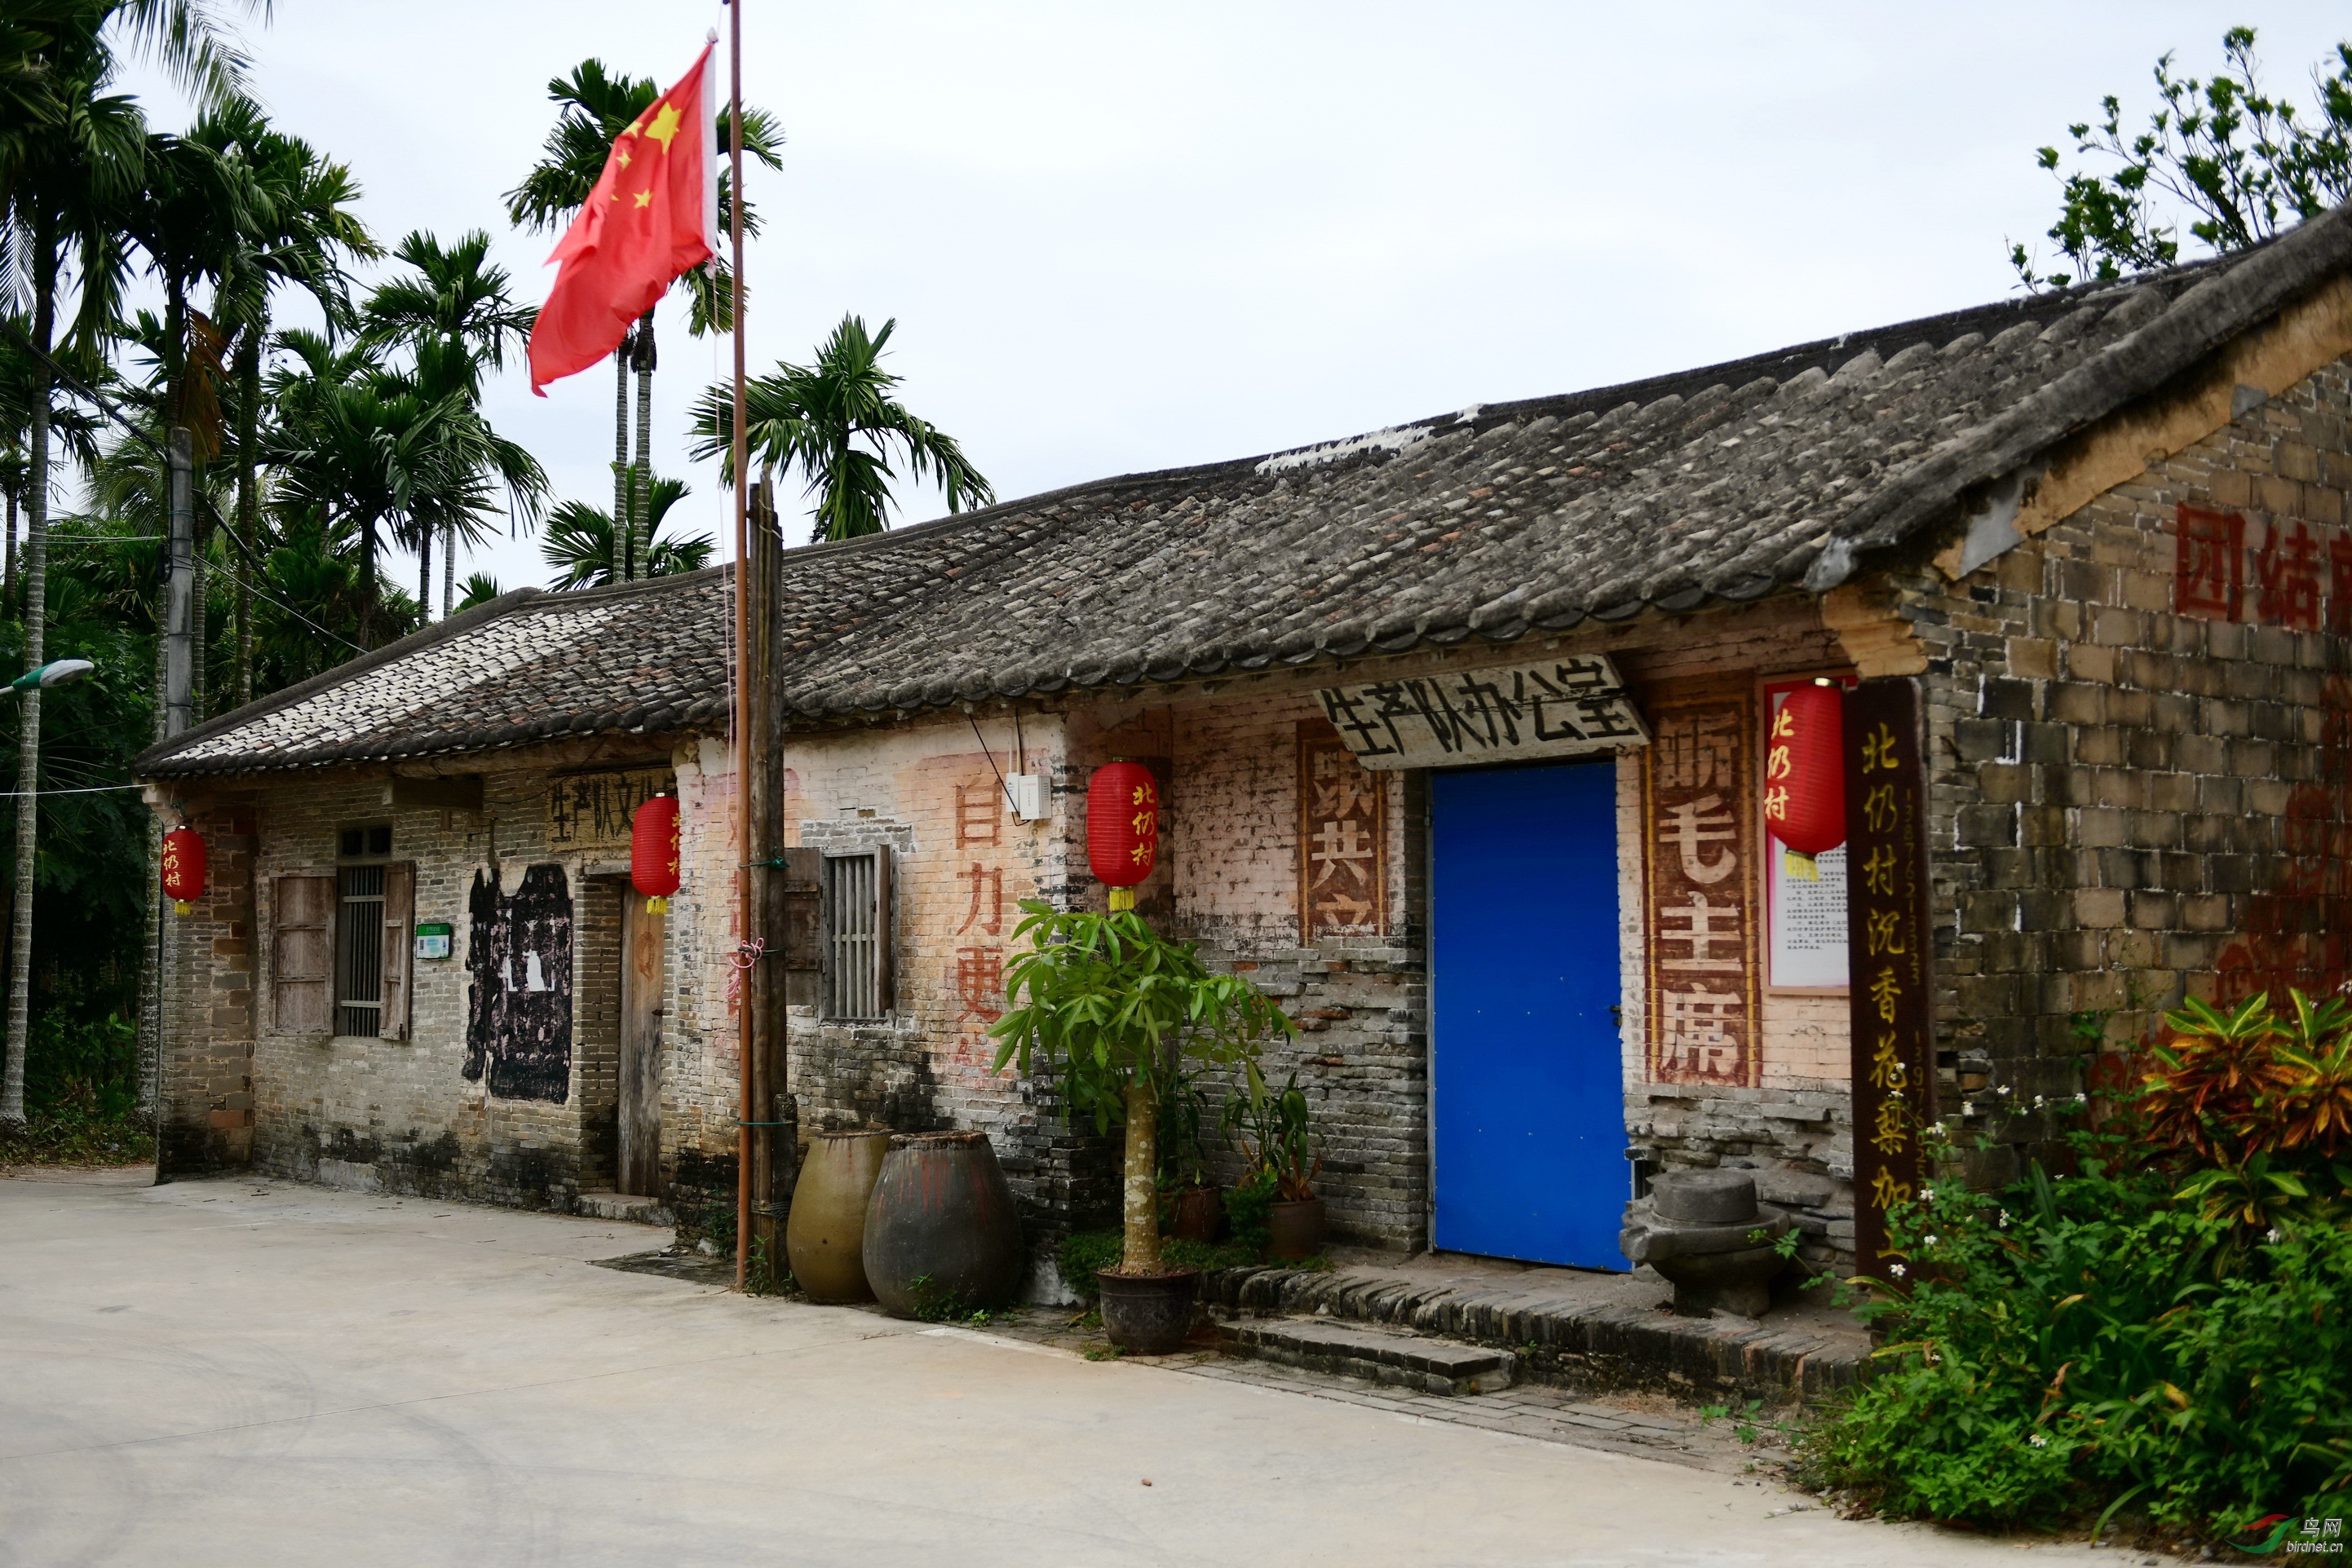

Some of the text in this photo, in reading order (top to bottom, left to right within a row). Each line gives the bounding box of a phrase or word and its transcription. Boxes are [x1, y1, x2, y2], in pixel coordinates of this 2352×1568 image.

[1320, 657, 1640, 757] 生产队办公室
[1764, 708, 1794, 821] 北仍村
[163, 840, 181, 887] 北仍村
[1130, 782, 1156, 867] 北仍村
[956, 777, 1004, 1068] 自力更
[1659, 711, 1744, 1076] 听毛主席
[1903, 788, 1921, 986] 13876213323
